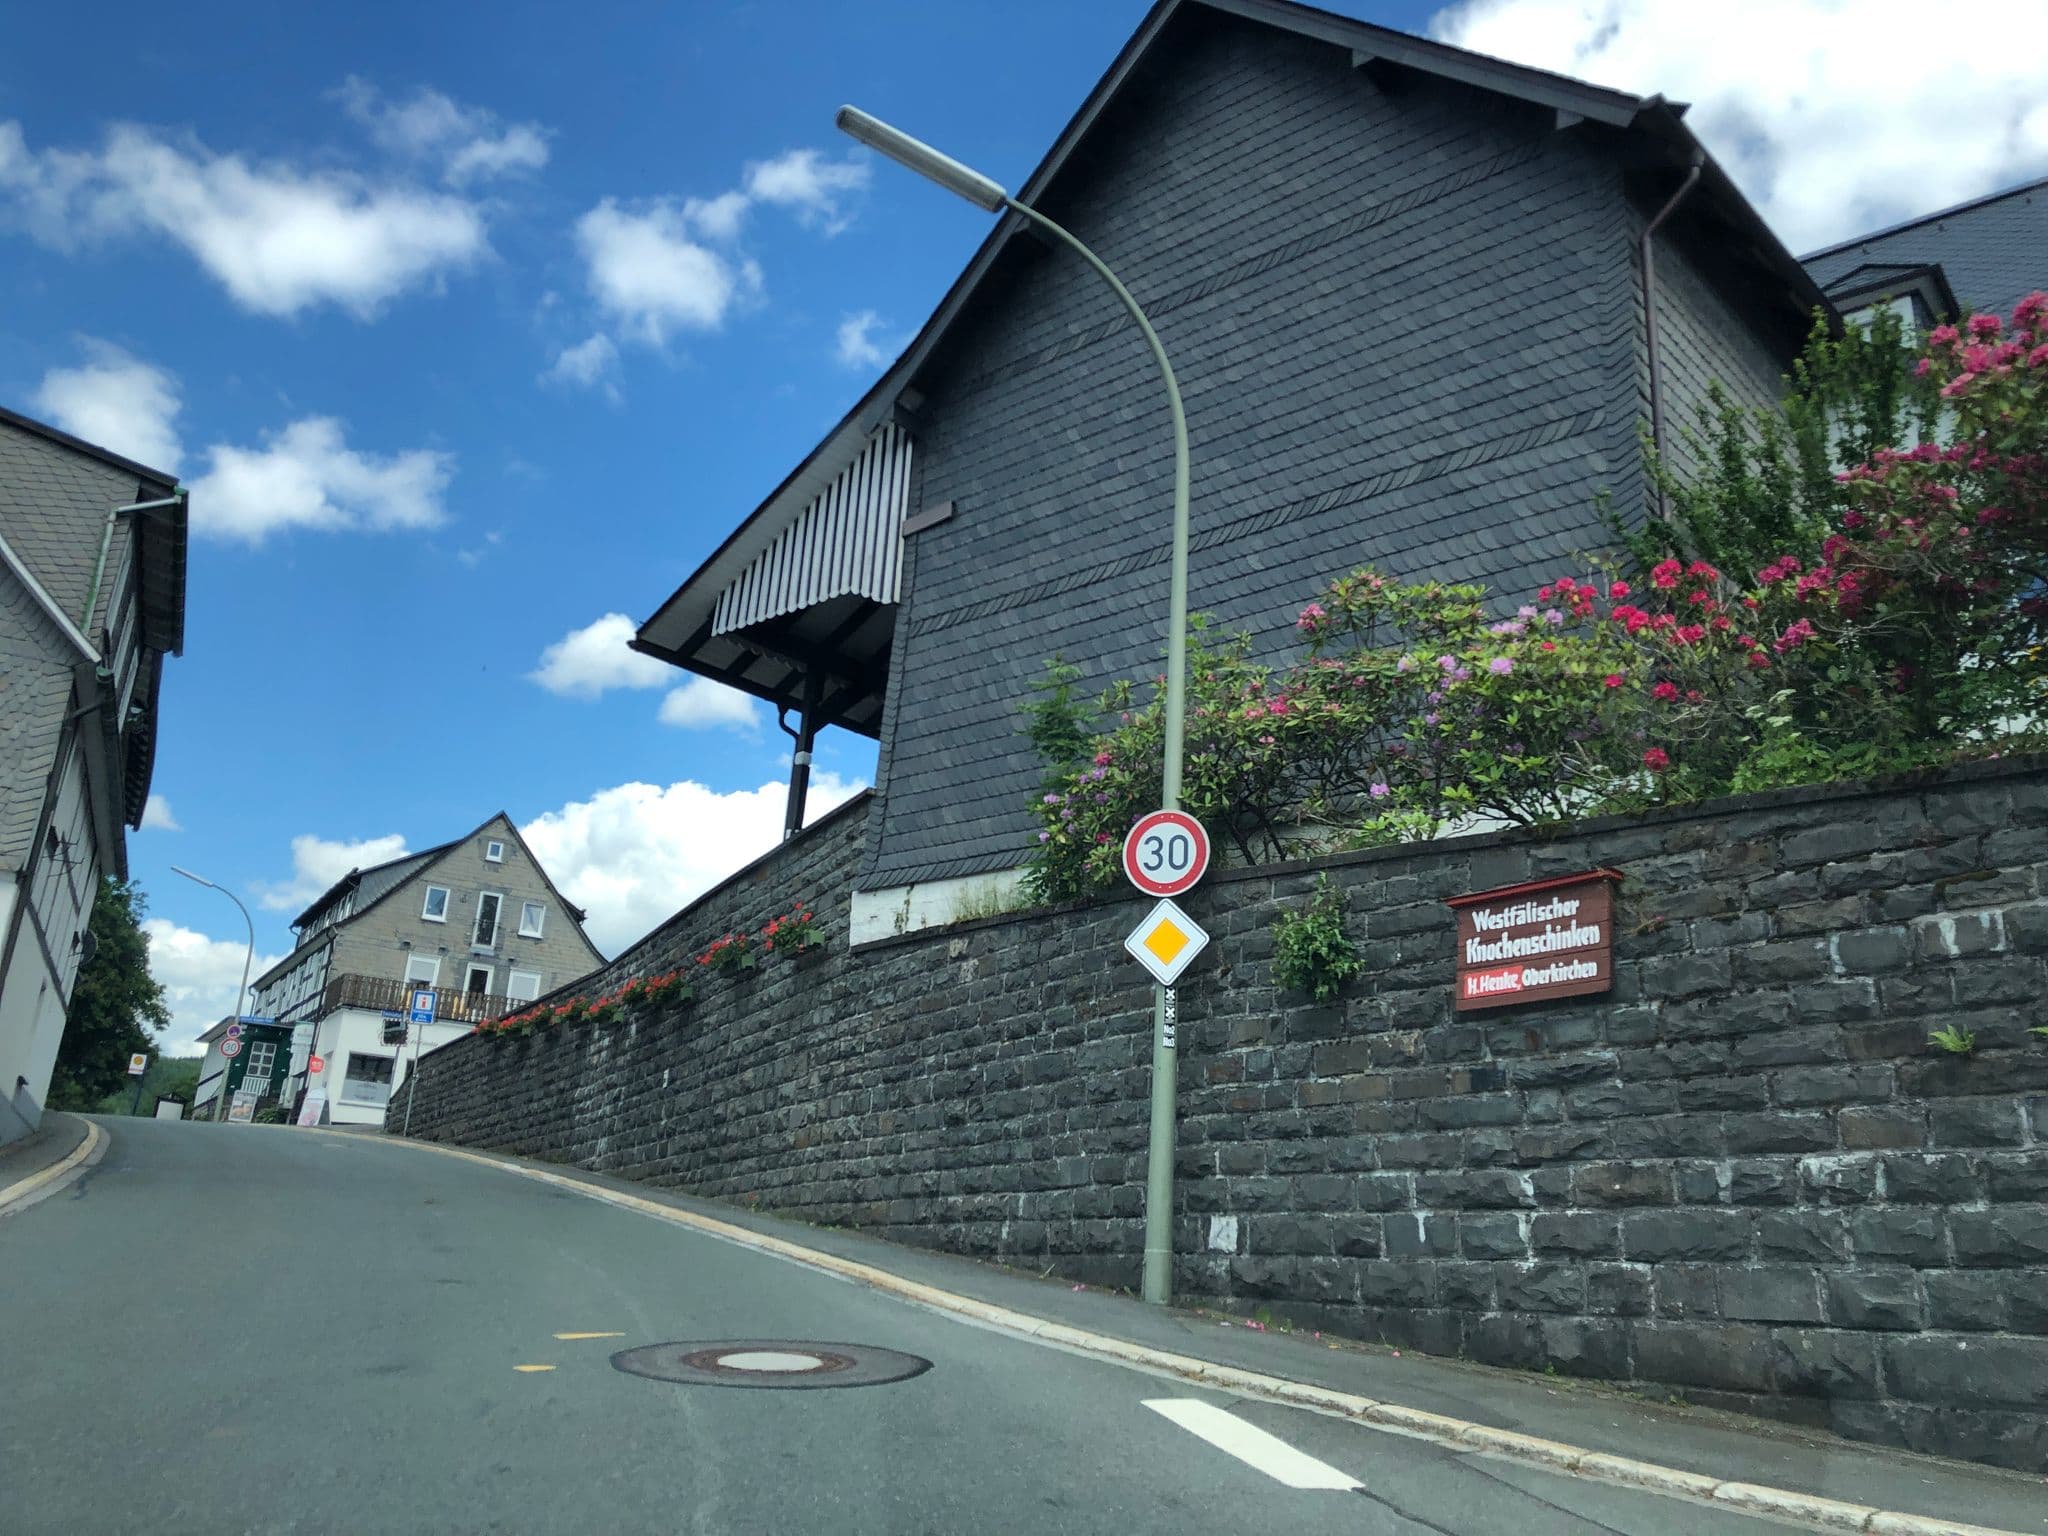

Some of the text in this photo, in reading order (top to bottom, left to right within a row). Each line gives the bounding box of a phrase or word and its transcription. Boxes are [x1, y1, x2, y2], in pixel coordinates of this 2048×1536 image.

[1143, 834, 1189, 871] 30
[1472, 897, 1580, 932] Westfälischer
[1466, 919, 1600, 963] Knochenschinken
[1522, 959, 1597, 986] Oberkirchen
[224, 1041, 238, 1052] 30
